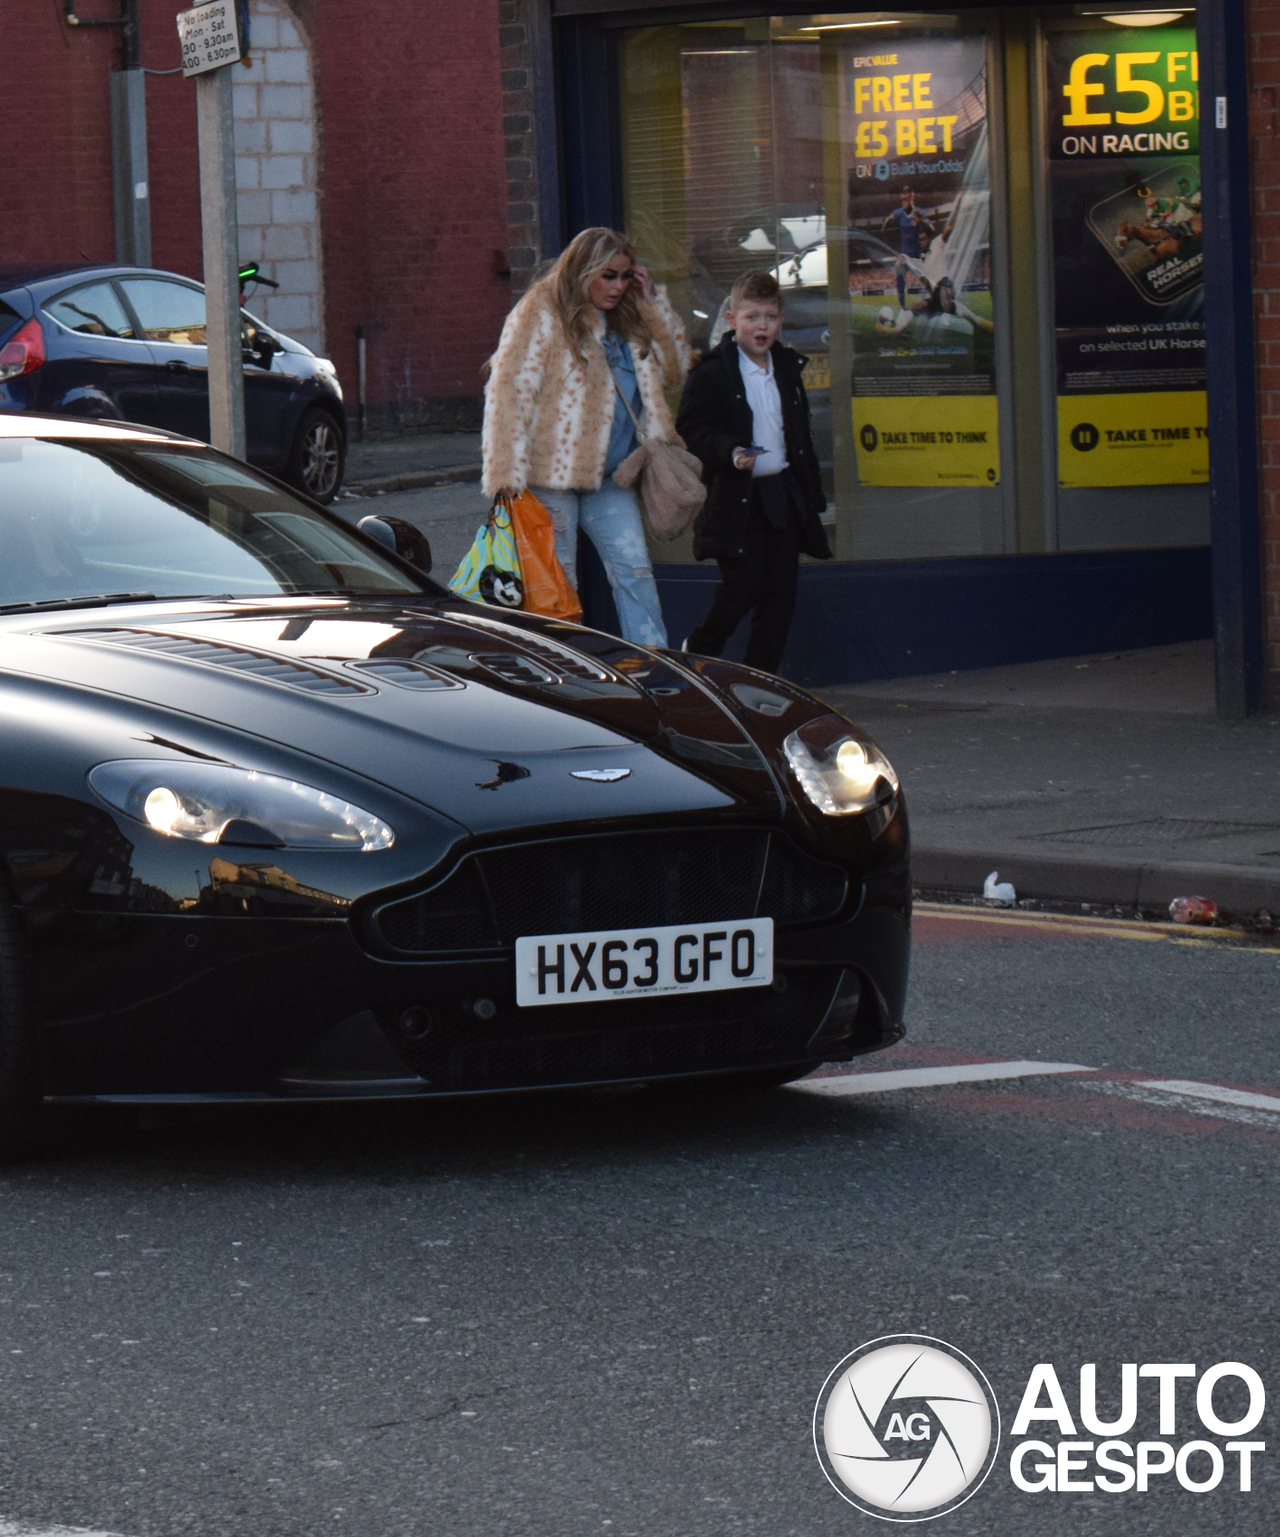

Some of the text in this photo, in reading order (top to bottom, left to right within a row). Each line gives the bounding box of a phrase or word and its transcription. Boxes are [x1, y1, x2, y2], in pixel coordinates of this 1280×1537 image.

[184, 7, 225, 26] No loading
[186, 28, 204, 40] Mon
[211, 20, 225, 32] Sat
[204, 33, 234, 49] 9.30am
[207, 47, 237, 62] 6.30pm
[854, 72, 933, 114] FREE
[1062, 51, 1165, 127] £5
[1168, 90, 1200, 122] B
[855, 115, 959, 158] £5 BET
[1062, 131, 1190, 155] ON RACING
[856, 164, 872, 178] ON
[891, 161, 916, 176] Build
[1147, 257, 1183, 281] REAL
[1107, 320, 1200, 334] when you stake
[1080, 343, 1095, 353] on
[1097, 340, 1147, 352] selected
[1148, 339, 1168, 350] UK
[881, 431, 987, 444] TAKE TIME TO THINK
[1104, 429, 1146, 442] TAKE
[1151, 427, 1190, 441] TIME
[537, 928, 755, 995] HX63 GFO
